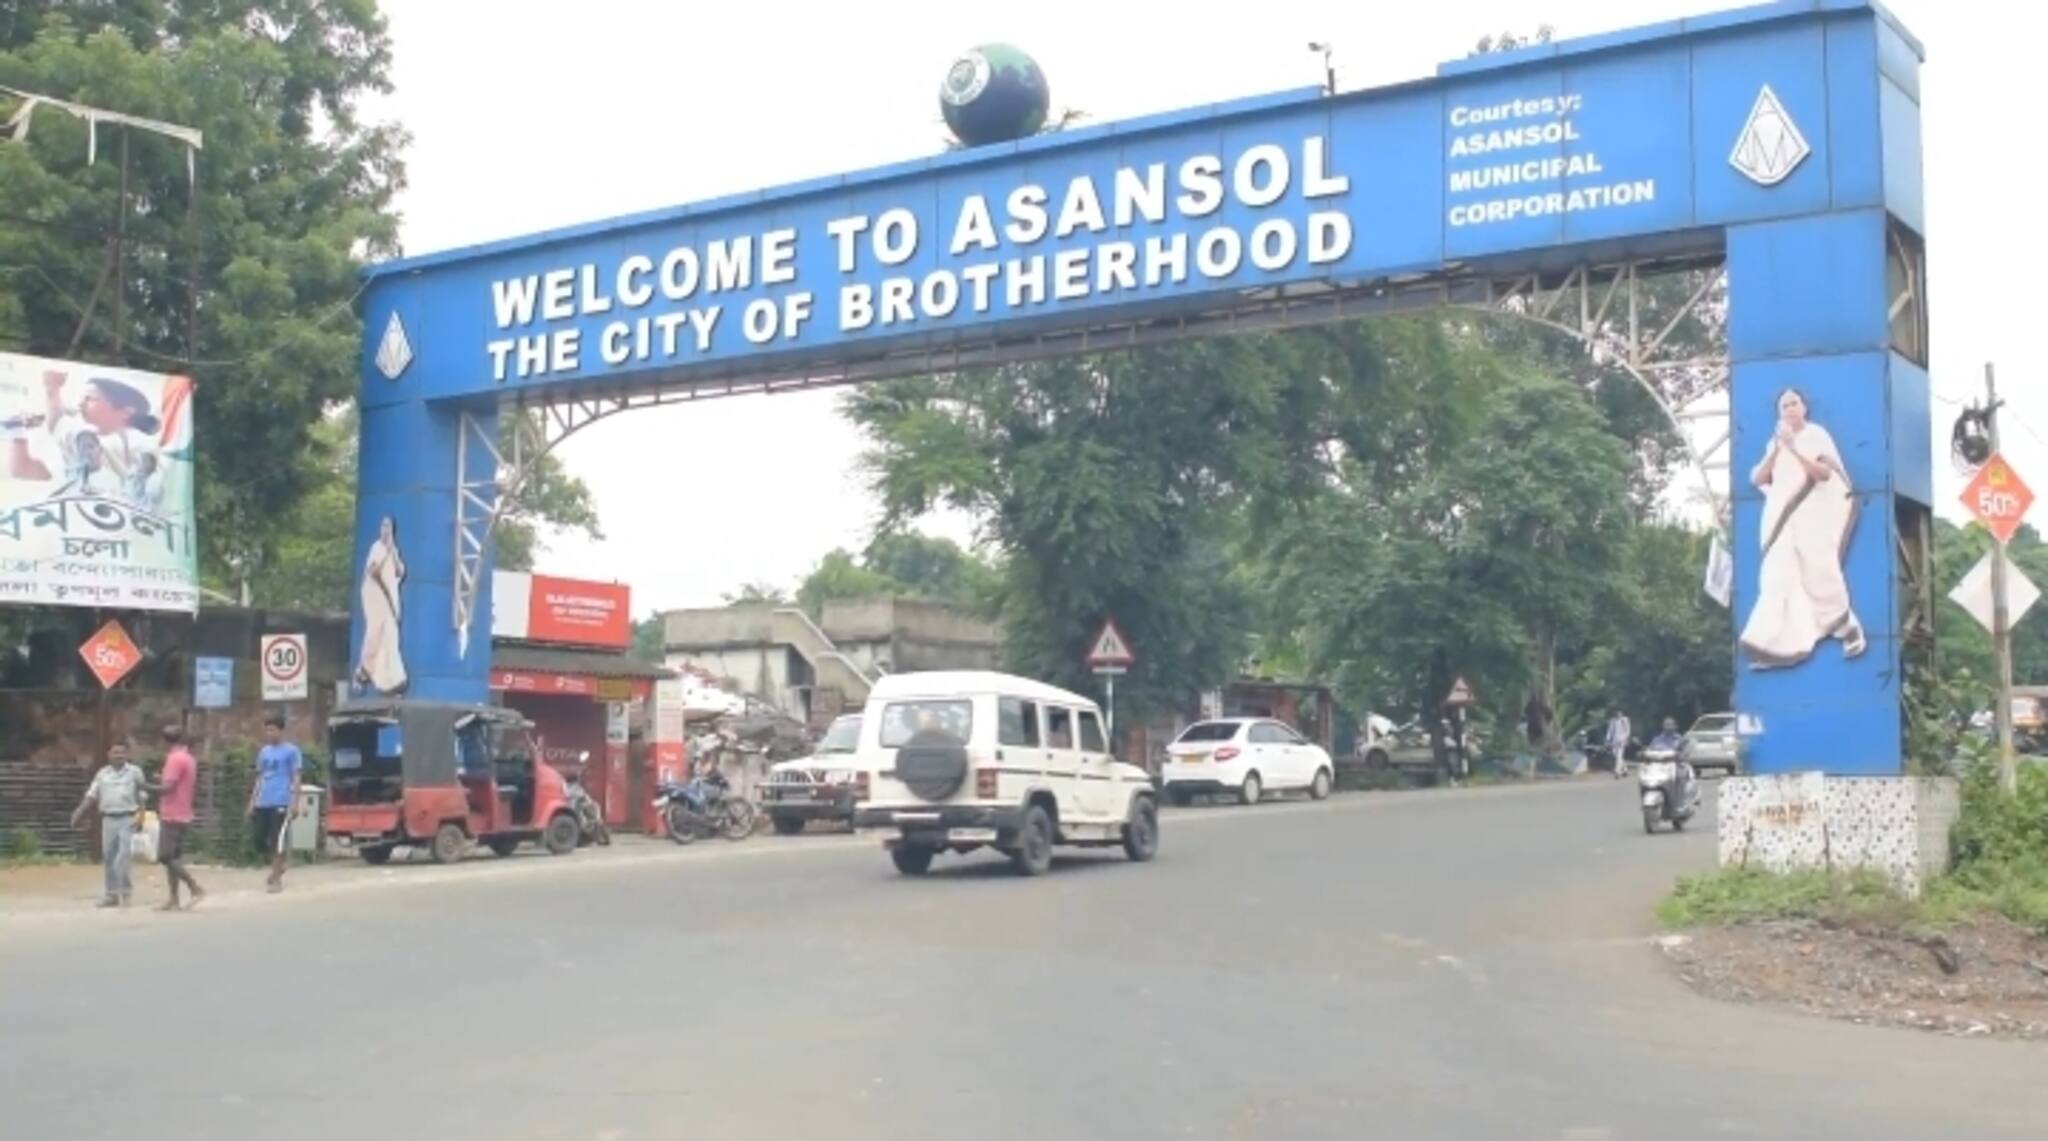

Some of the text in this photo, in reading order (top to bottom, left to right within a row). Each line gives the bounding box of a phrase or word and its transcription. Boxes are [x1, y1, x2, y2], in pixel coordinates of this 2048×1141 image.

[1450, 94, 1582, 127] Courtesy:
[1450, 120, 1580, 157] ASANSOL
[1450, 153, 1603, 192] MUNICIPAL
[1449, 179, 1655, 226] CORPORATION
[491, 136, 1350, 329] WELCOME TO ASANSOL
[487, 212, 1353, 380] THE CITY OF BROTHERHOOD
[272, 648, 297, 667] 30
